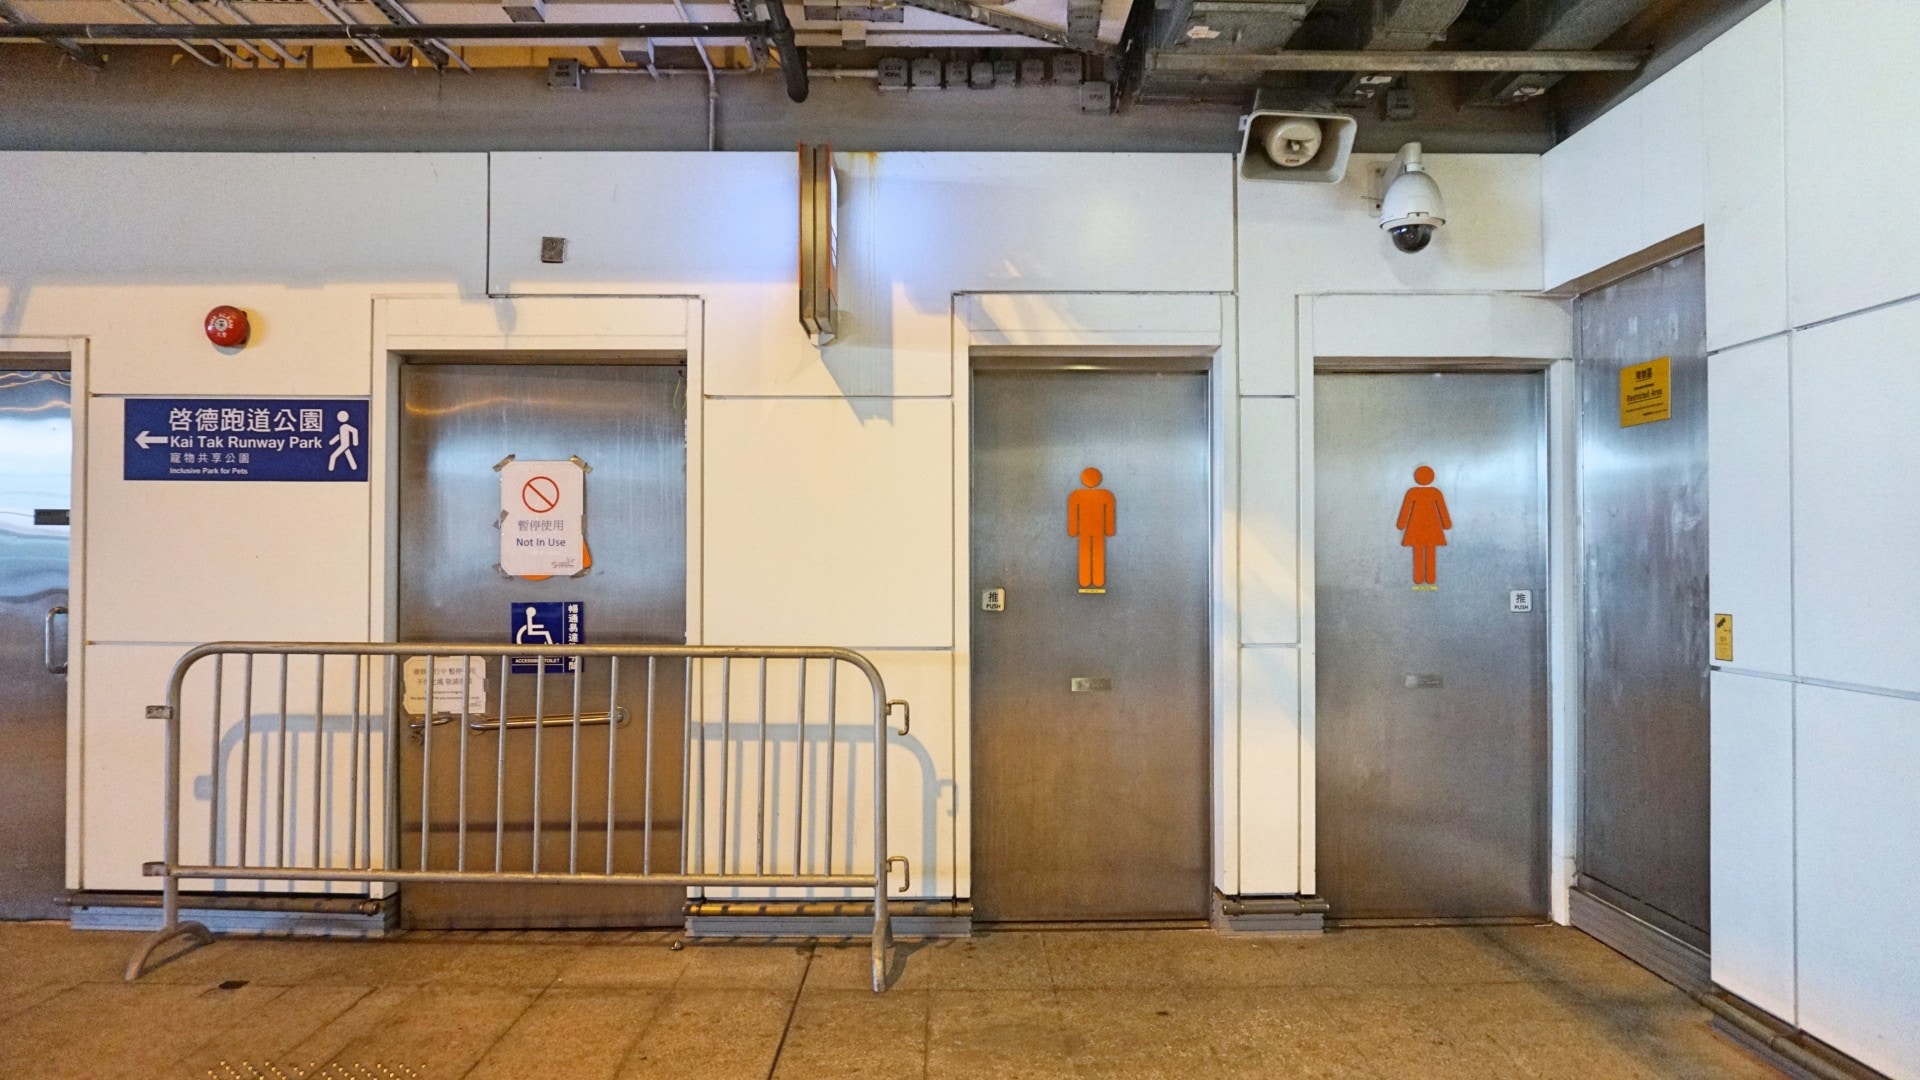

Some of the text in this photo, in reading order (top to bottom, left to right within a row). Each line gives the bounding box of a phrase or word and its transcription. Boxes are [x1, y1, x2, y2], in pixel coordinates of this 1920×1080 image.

[170, 436, 322, 452] Kai Tak Runway Park
[518, 520, 564, 531] 暫停使用
[516, 538, 566, 546] Not In Use
[988, 592, 999, 602] 推
[1516, 593, 1526, 603] 推
